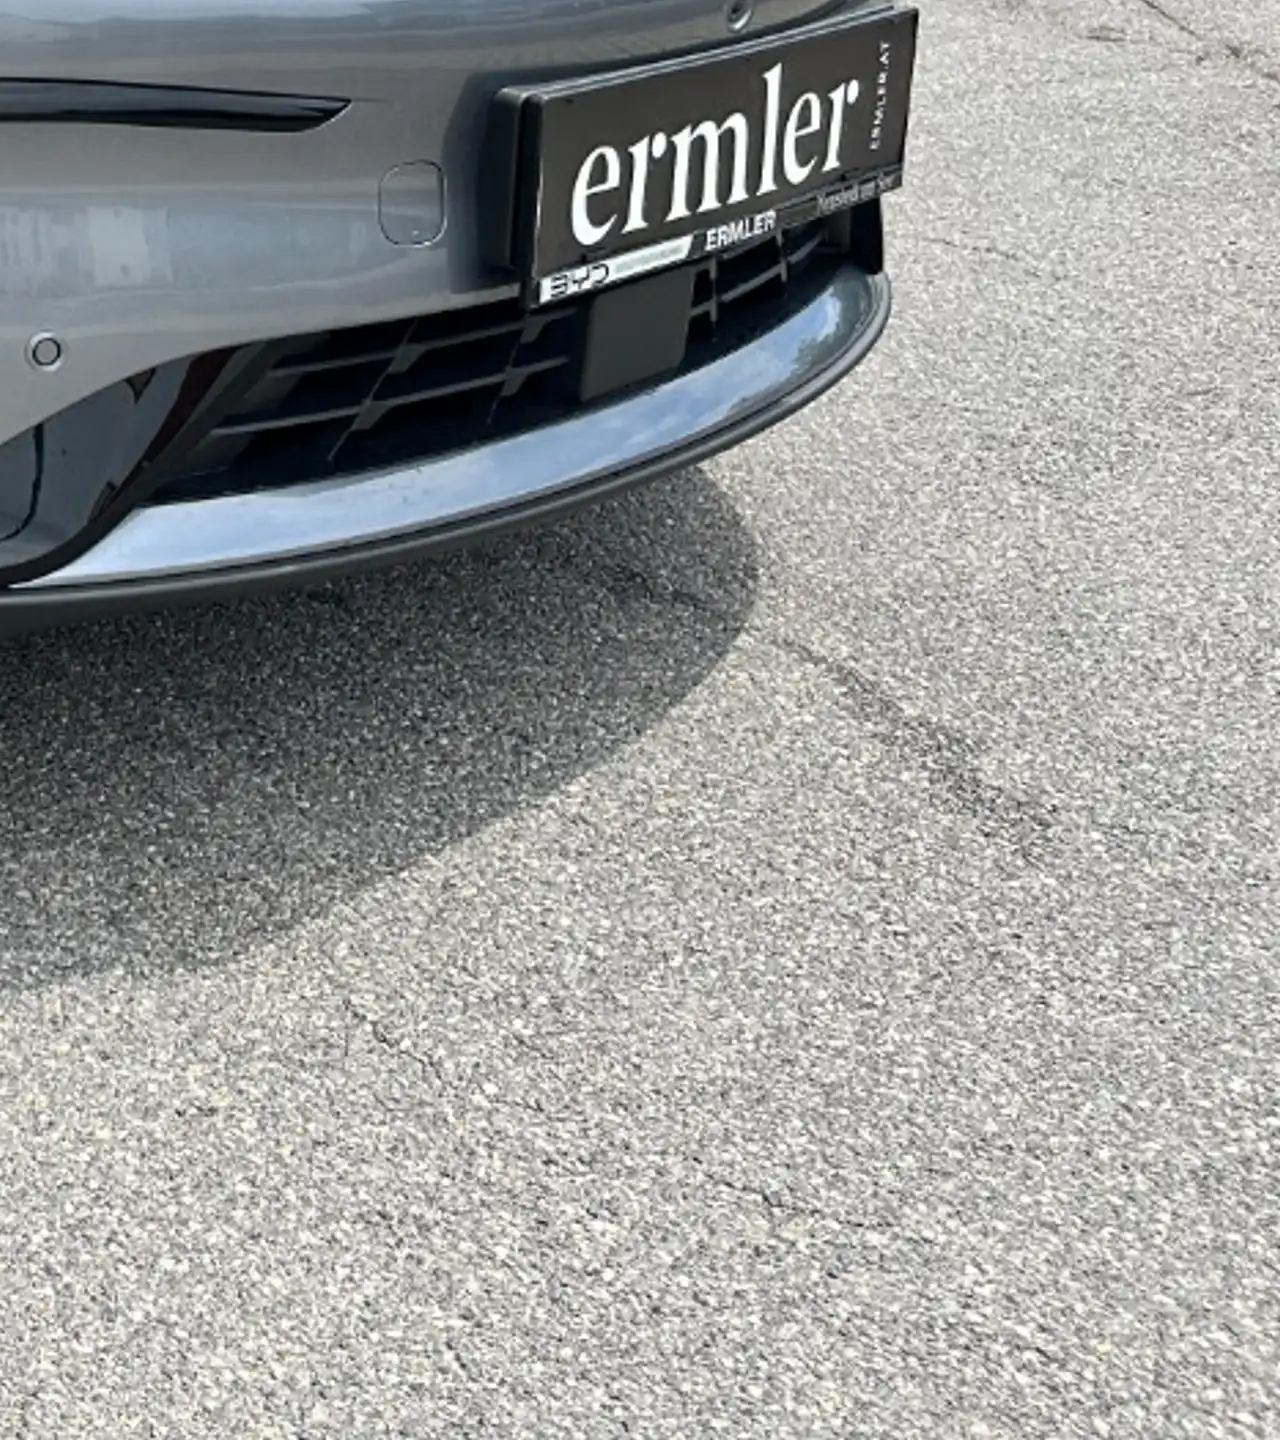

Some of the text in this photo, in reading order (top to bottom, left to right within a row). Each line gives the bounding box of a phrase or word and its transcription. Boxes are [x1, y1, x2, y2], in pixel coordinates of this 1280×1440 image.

[570, 62, 861, 246] ermler
[550, 208, 777, 299] BYD ERMLER
